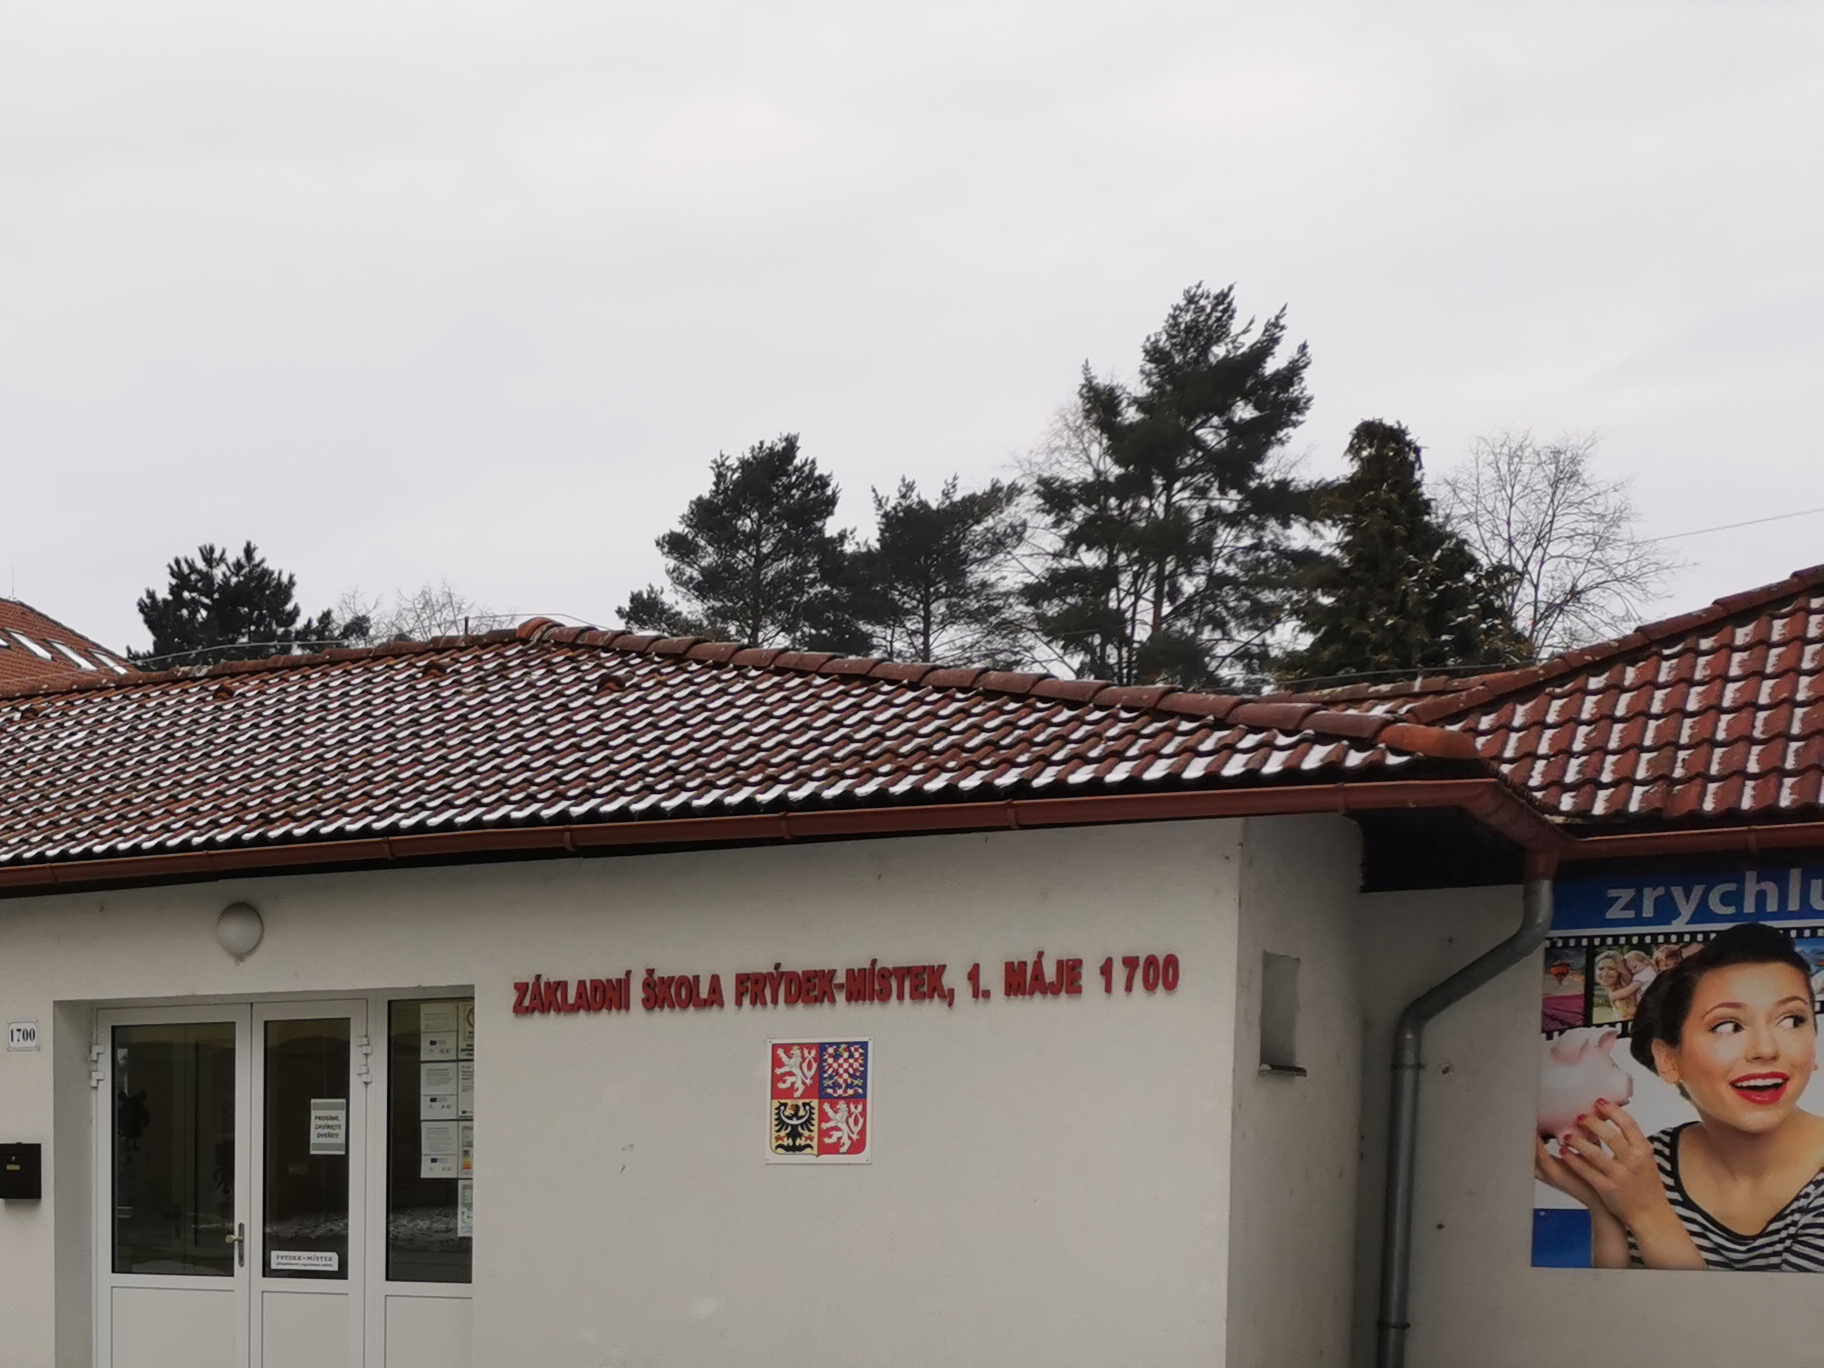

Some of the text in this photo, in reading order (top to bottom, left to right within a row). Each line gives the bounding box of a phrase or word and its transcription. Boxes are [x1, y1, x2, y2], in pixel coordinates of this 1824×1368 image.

[512, 950, 1179, 1014] ZÁKLADNÍ ŠKOLA FRÝDEK-MÍSTEK, 1. MÁJE 1700
[10, 1028, 36, 1043] 1700
